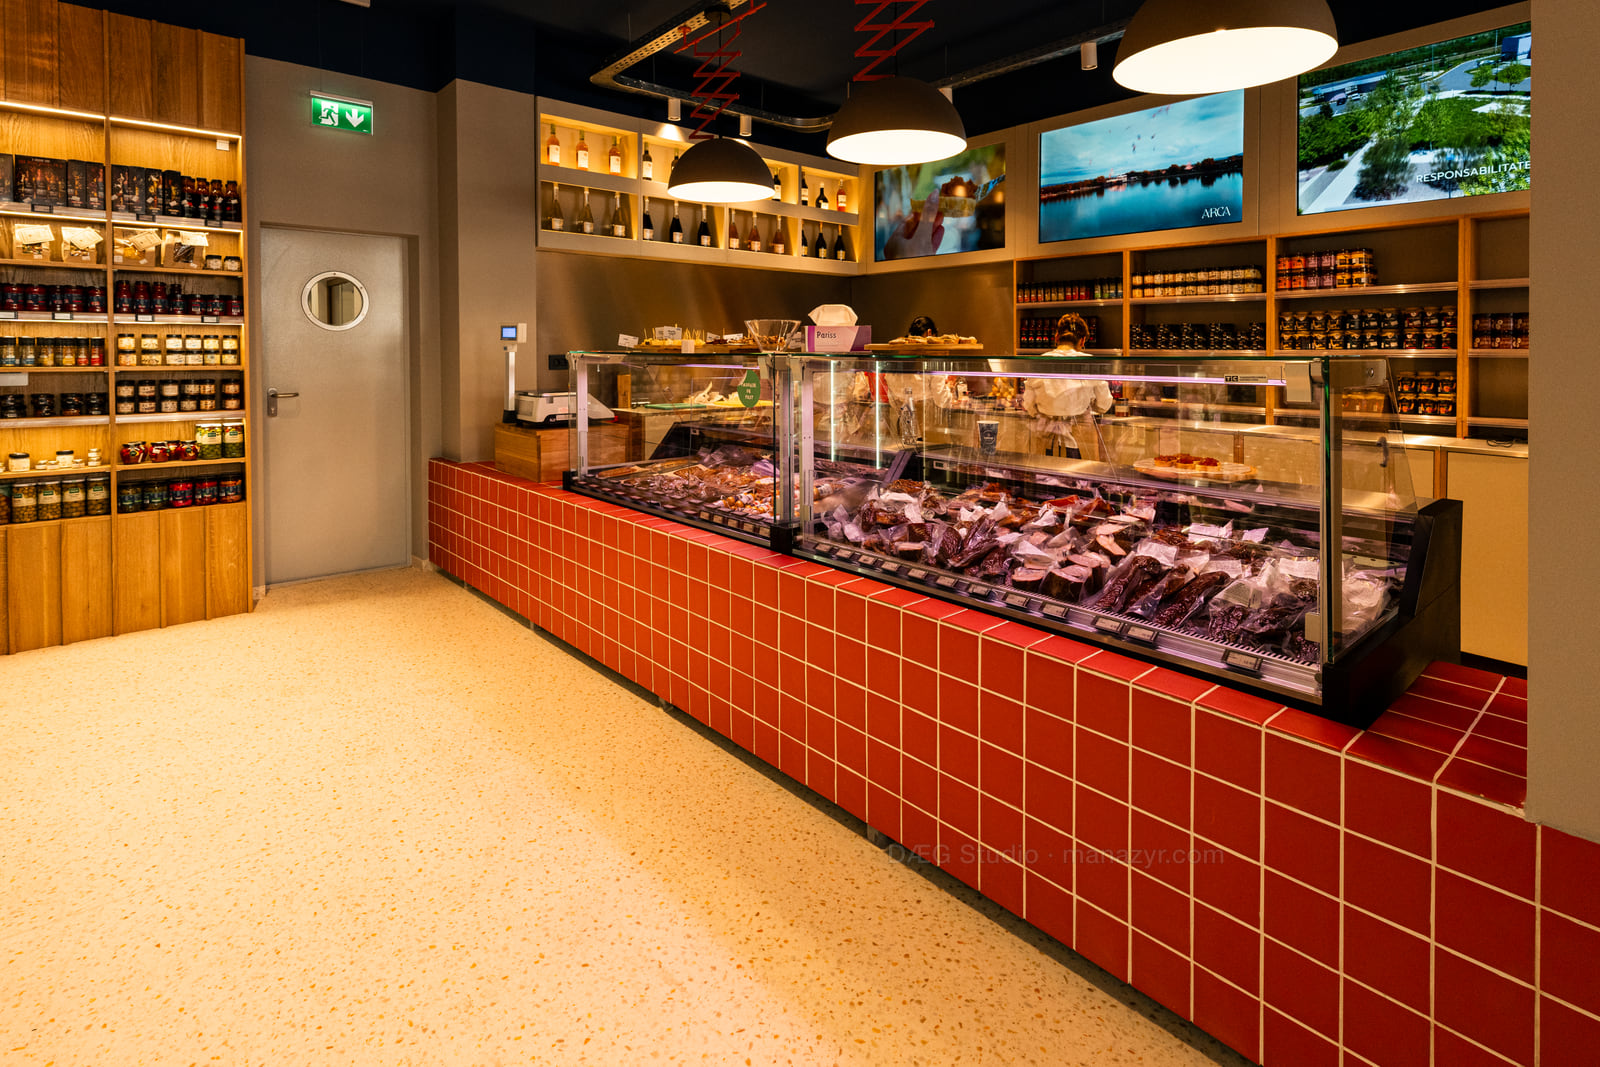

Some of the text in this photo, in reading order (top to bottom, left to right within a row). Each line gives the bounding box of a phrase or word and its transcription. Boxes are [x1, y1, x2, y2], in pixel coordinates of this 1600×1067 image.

[1416, 160, 1530, 183] RESPONSABILITATE
[1201, 206, 1231, 219] ARCA
[816, 331, 837, 339] Pariss
